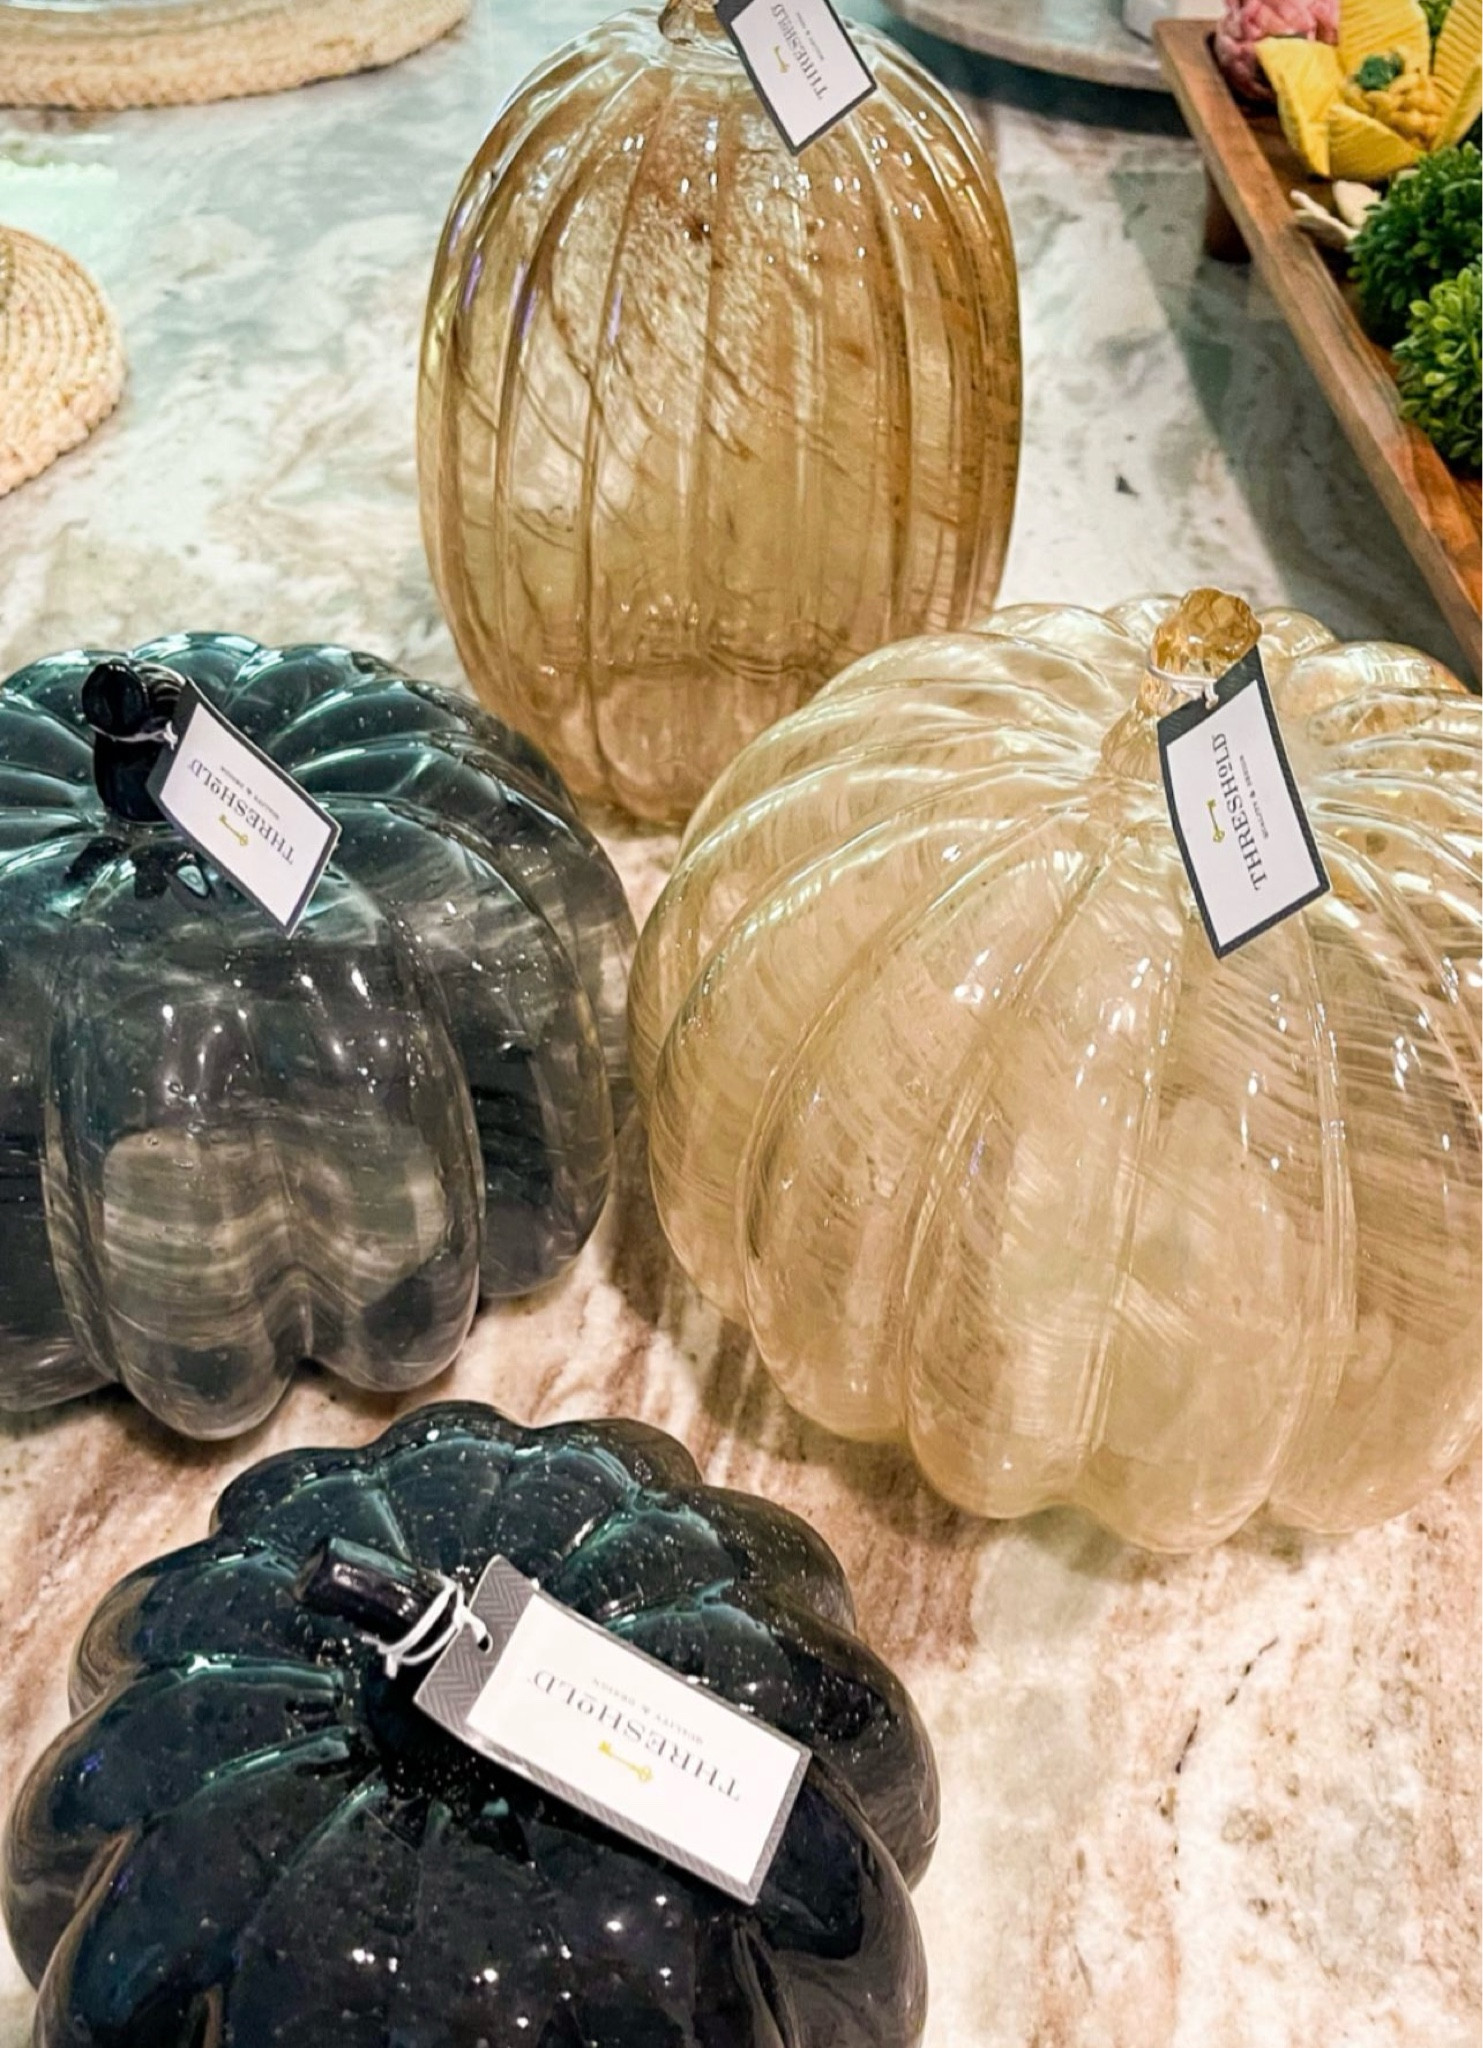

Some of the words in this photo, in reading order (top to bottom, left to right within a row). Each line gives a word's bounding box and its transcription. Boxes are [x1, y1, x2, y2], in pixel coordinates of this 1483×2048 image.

[189, 758, 295, 865] THRESHOLD
[1211, 732, 1268, 891] THRESHOLD
[532, 1668, 741, 1802] THRESHOLD
